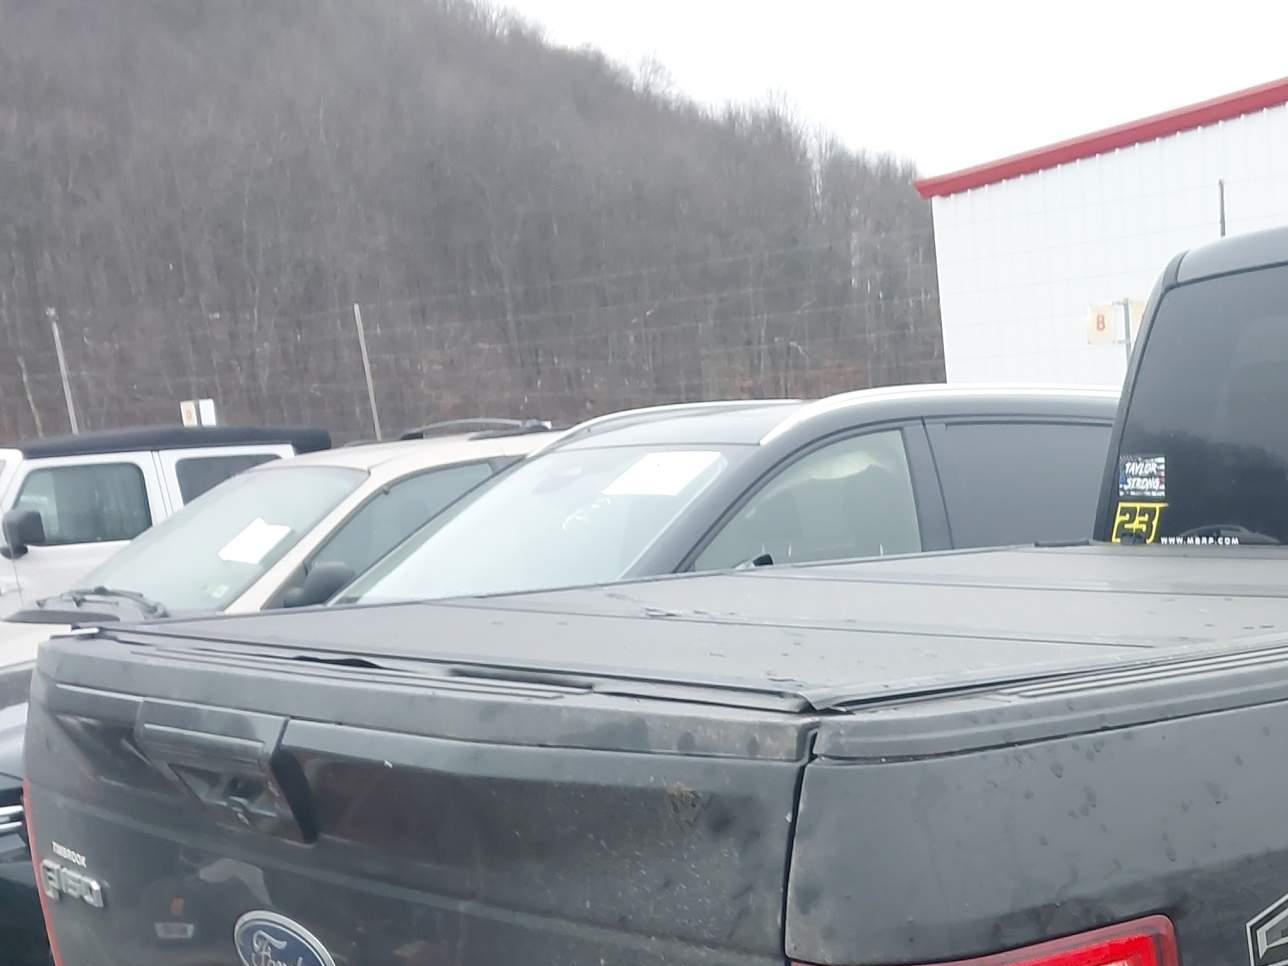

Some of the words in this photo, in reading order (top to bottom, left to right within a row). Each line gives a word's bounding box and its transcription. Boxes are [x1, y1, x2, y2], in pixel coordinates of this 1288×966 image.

[1125, 462, 1157, 475] TAYLOR
[1124, 477, 1160, 490] STRONG
[1112, 502, 1160, 544] 23
